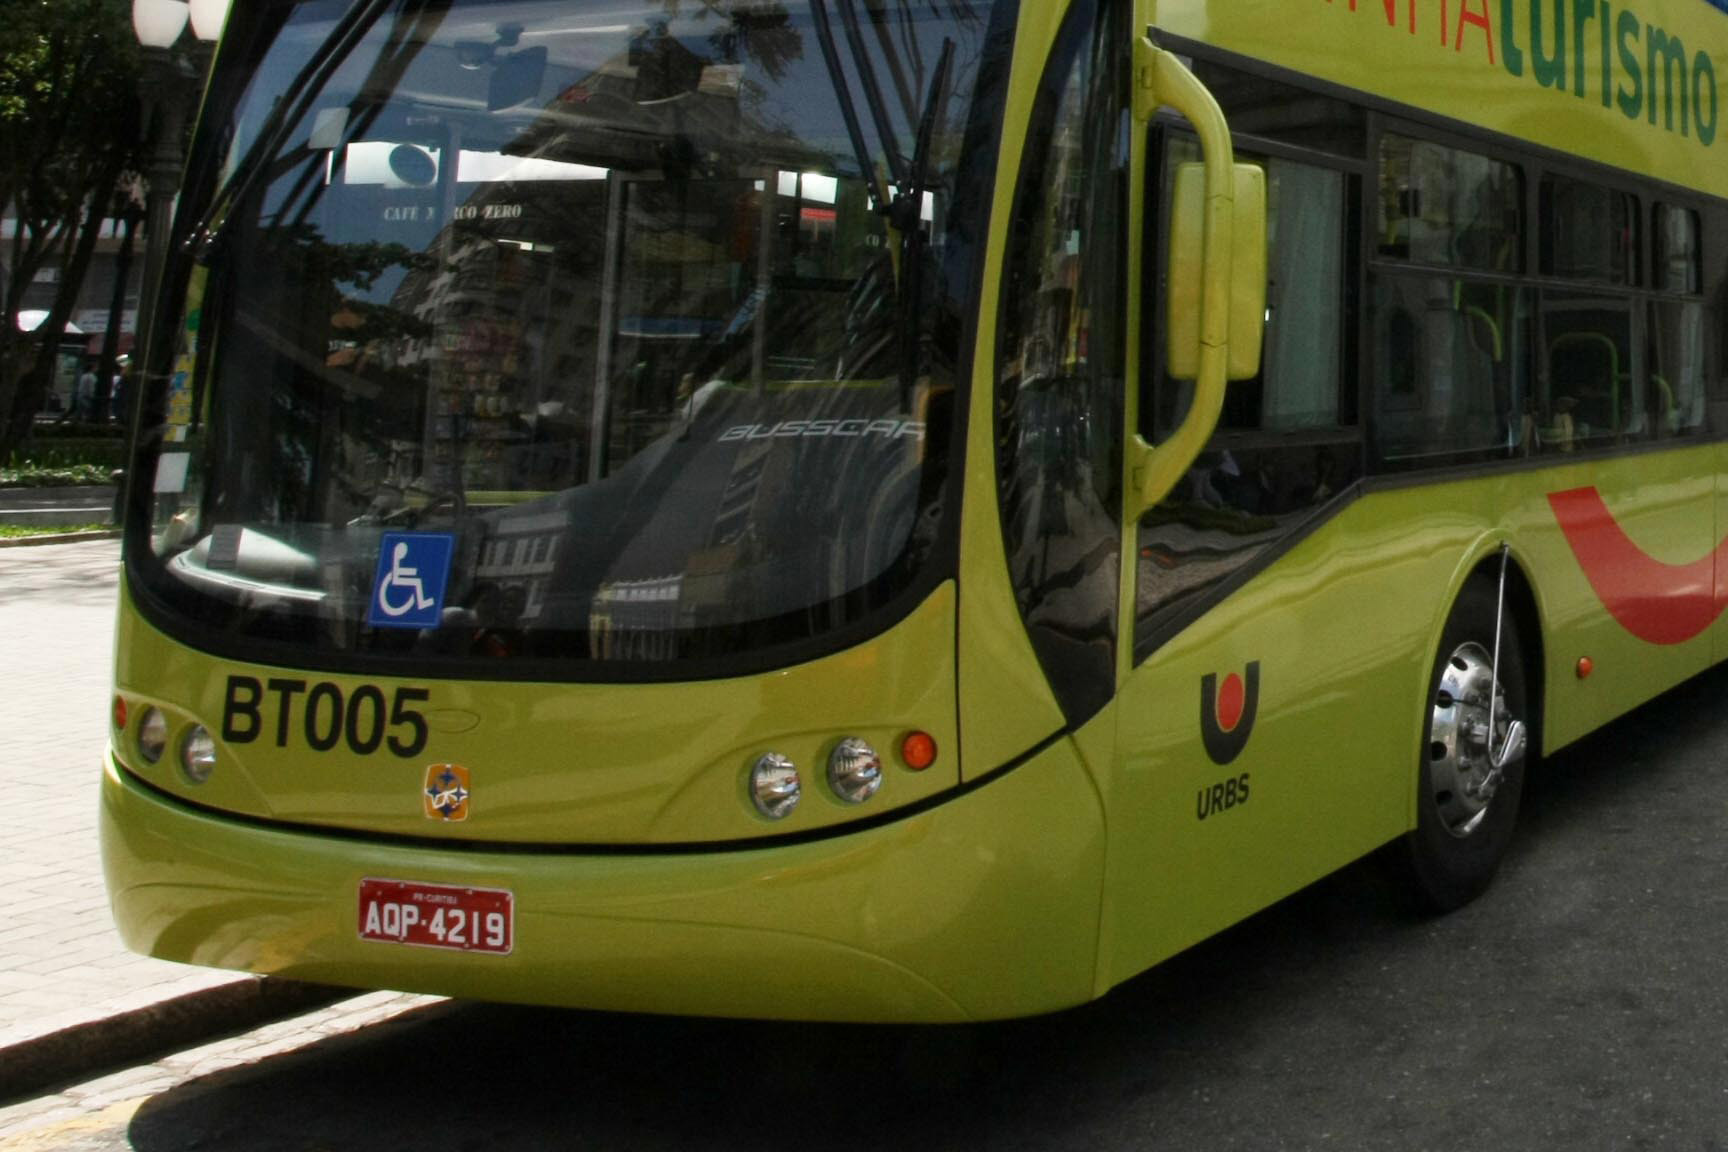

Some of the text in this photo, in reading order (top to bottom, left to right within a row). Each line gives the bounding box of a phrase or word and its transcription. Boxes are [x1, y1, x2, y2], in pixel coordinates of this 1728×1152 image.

[484, 204, 522, 219] ZERO
[717, 419, 927, 443] BUSSCAR
[222, 675, 430, 758] BT005
[1197, 772, 1250, 821] URBS
